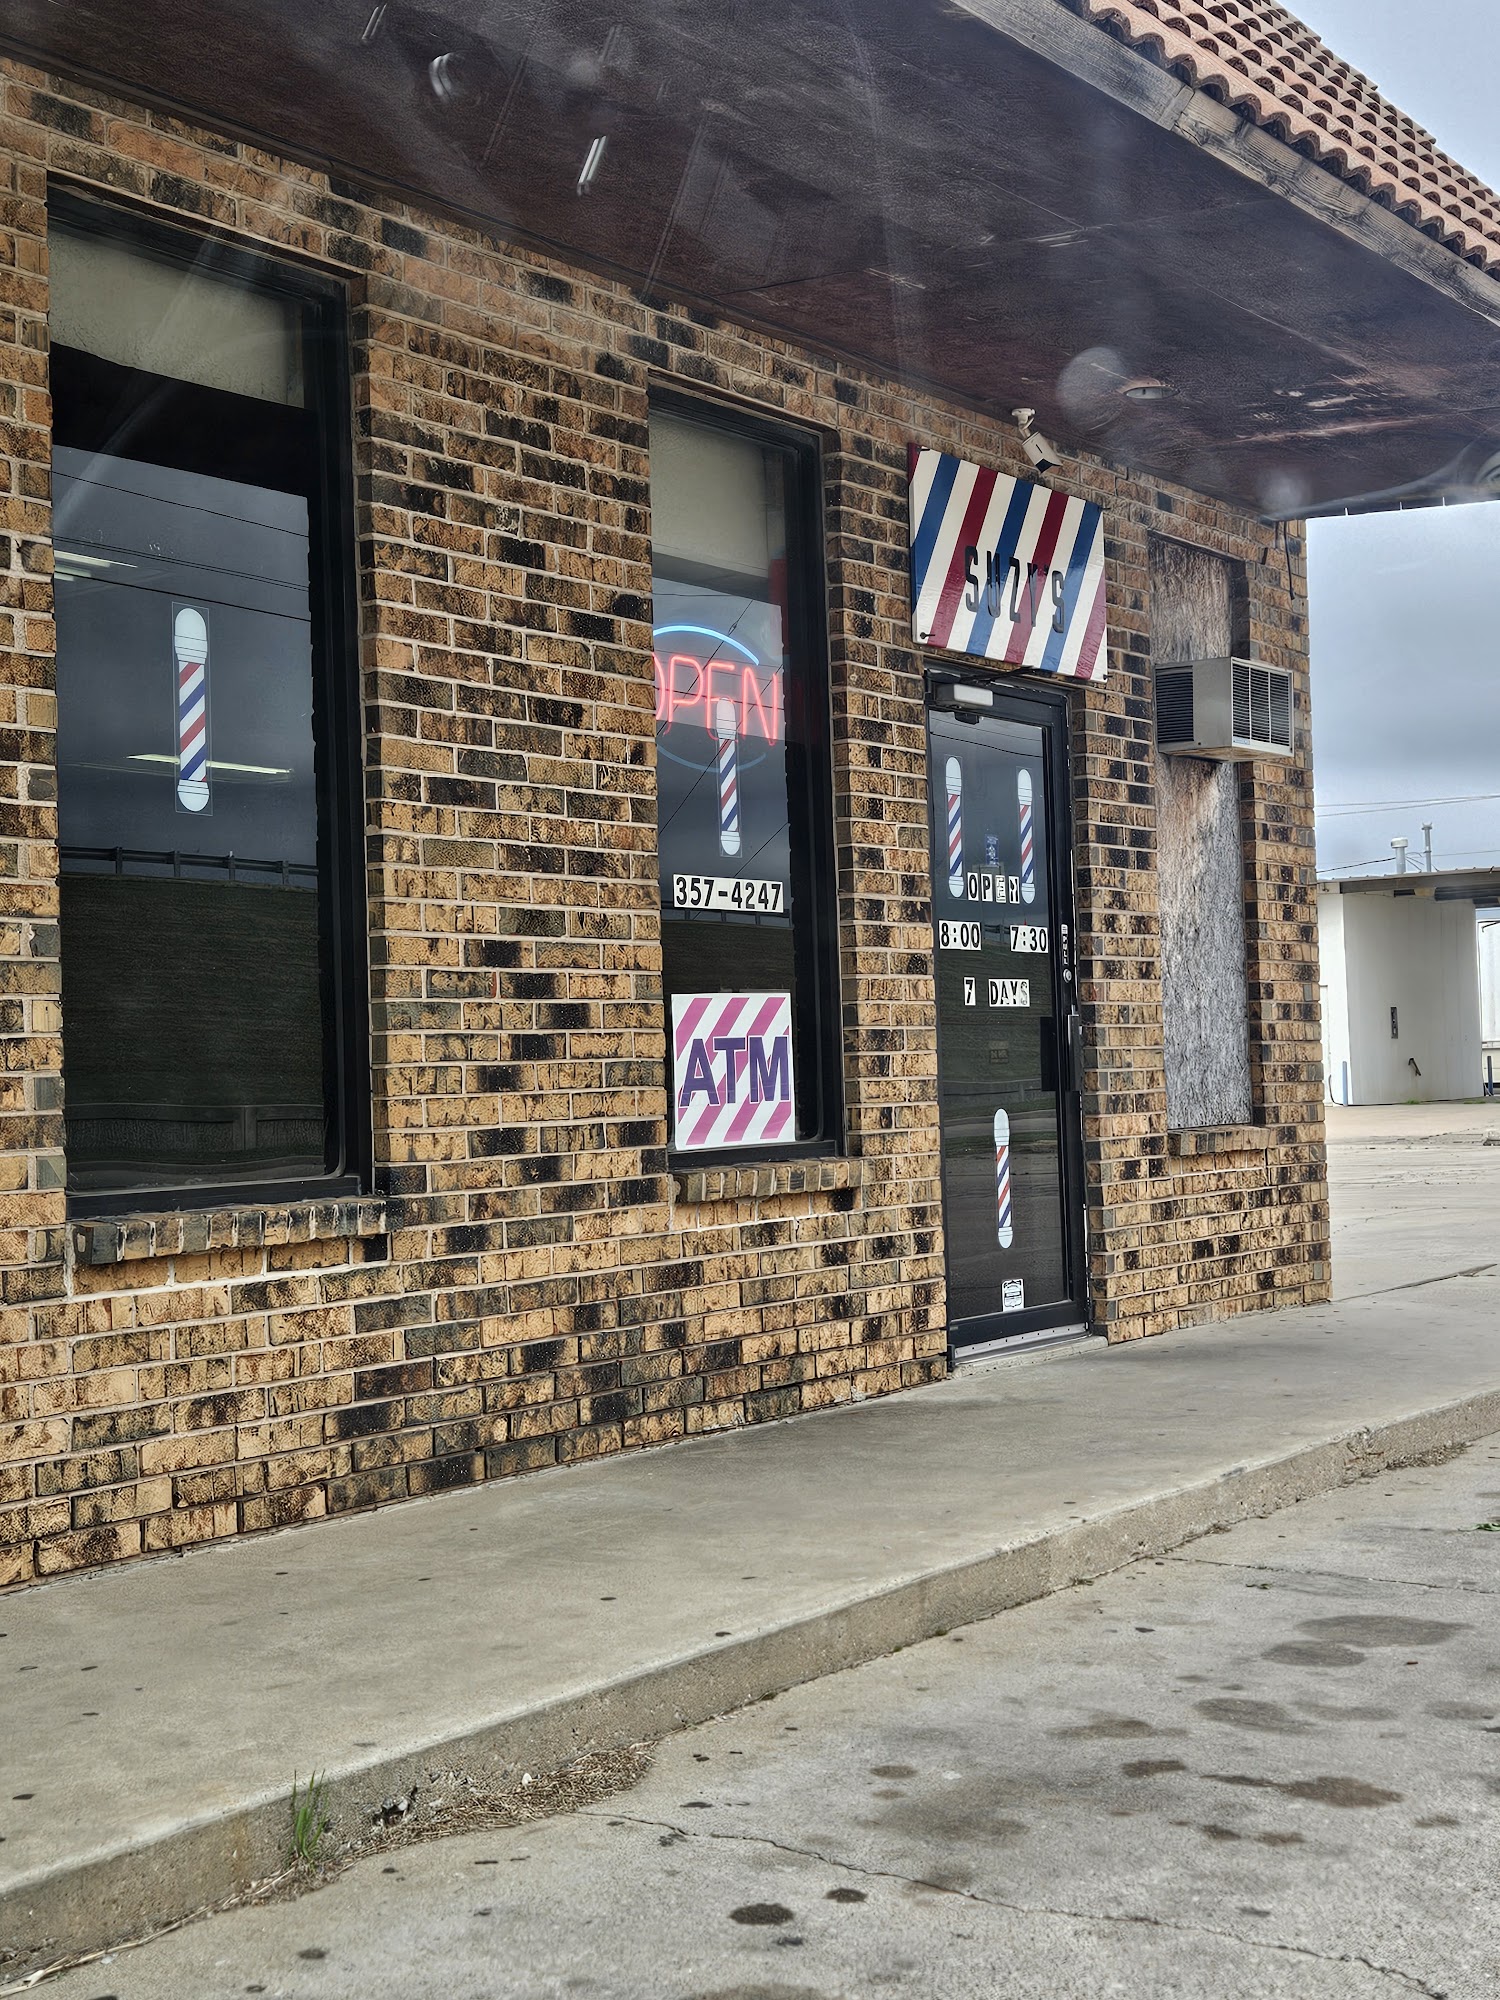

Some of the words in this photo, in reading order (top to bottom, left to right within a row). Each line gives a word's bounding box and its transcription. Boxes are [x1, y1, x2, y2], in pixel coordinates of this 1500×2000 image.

[965, 546, 1065, 633] SUZY'S
[676, 877, 781, 910] 357-4247
[941, 922, 980, 948] 8:00
[1011, 926, 1047, 952] 7:30
[965, 979, 974, 1004] 7
[990, 981, 1028, 1005] DAYS
[680, 1036, 789, 1107] ATM
